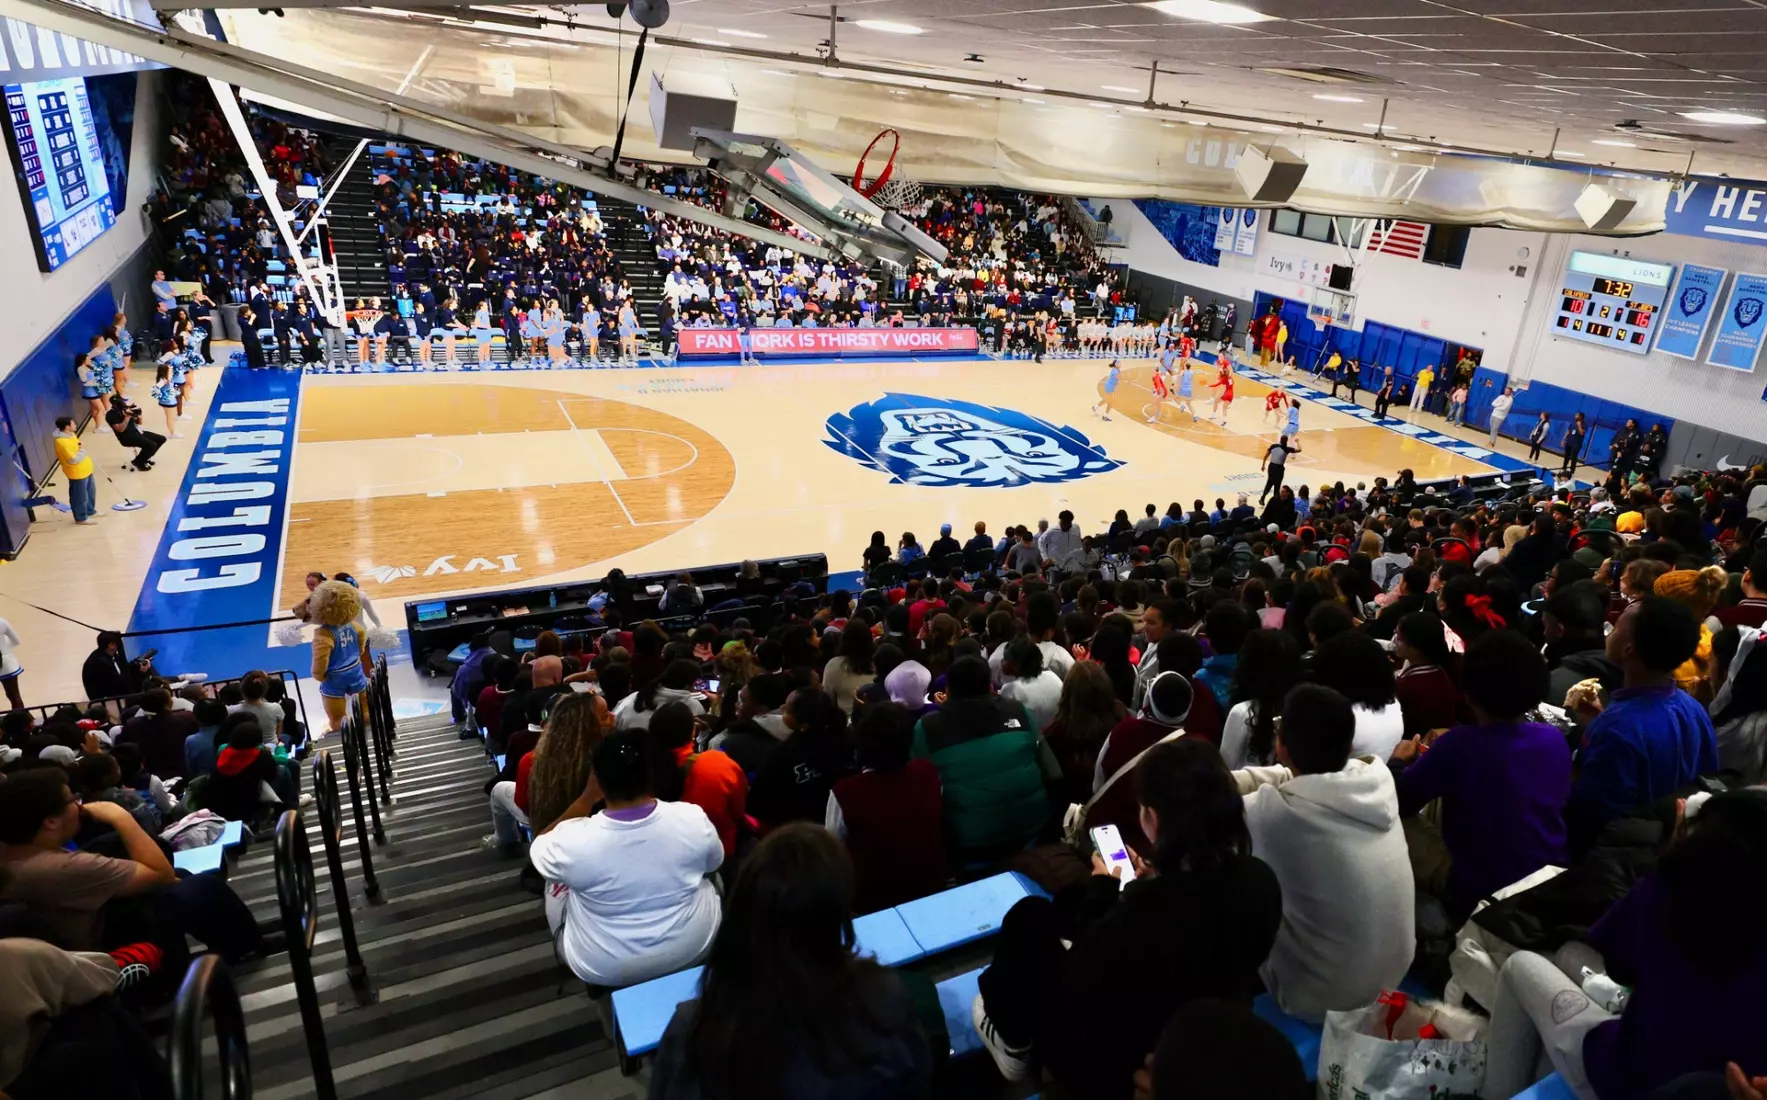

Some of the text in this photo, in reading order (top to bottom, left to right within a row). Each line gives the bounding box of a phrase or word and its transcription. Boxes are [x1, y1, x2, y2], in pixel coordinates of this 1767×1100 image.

[1709, 185, 1767, 223] HE
[1269, 256, 1286, 272] Ivy
[1633, 268, 1662, 279] LIONS
[1564, 289, 1590, 300] COLUMBIA
[1605, 280, 1633, 297] 7:32
[1570, 300, 1584, 314] 10
[1601, 306, 1610, 318] 2
[1635, 312, 1651, 328] 16
[1574, 320, 1581, 330] 4
[1618, 329, 1626, 340] 4
[695, 335, 732, 349] FAN
[799, 334, 815, 347] IS
[820, 332, 891, 348] THIRSTY
[892, 332, 943, 346] WORK
[157, 398, 290, 593] COLUMBIA
[339, 629, 354, 648] 54
